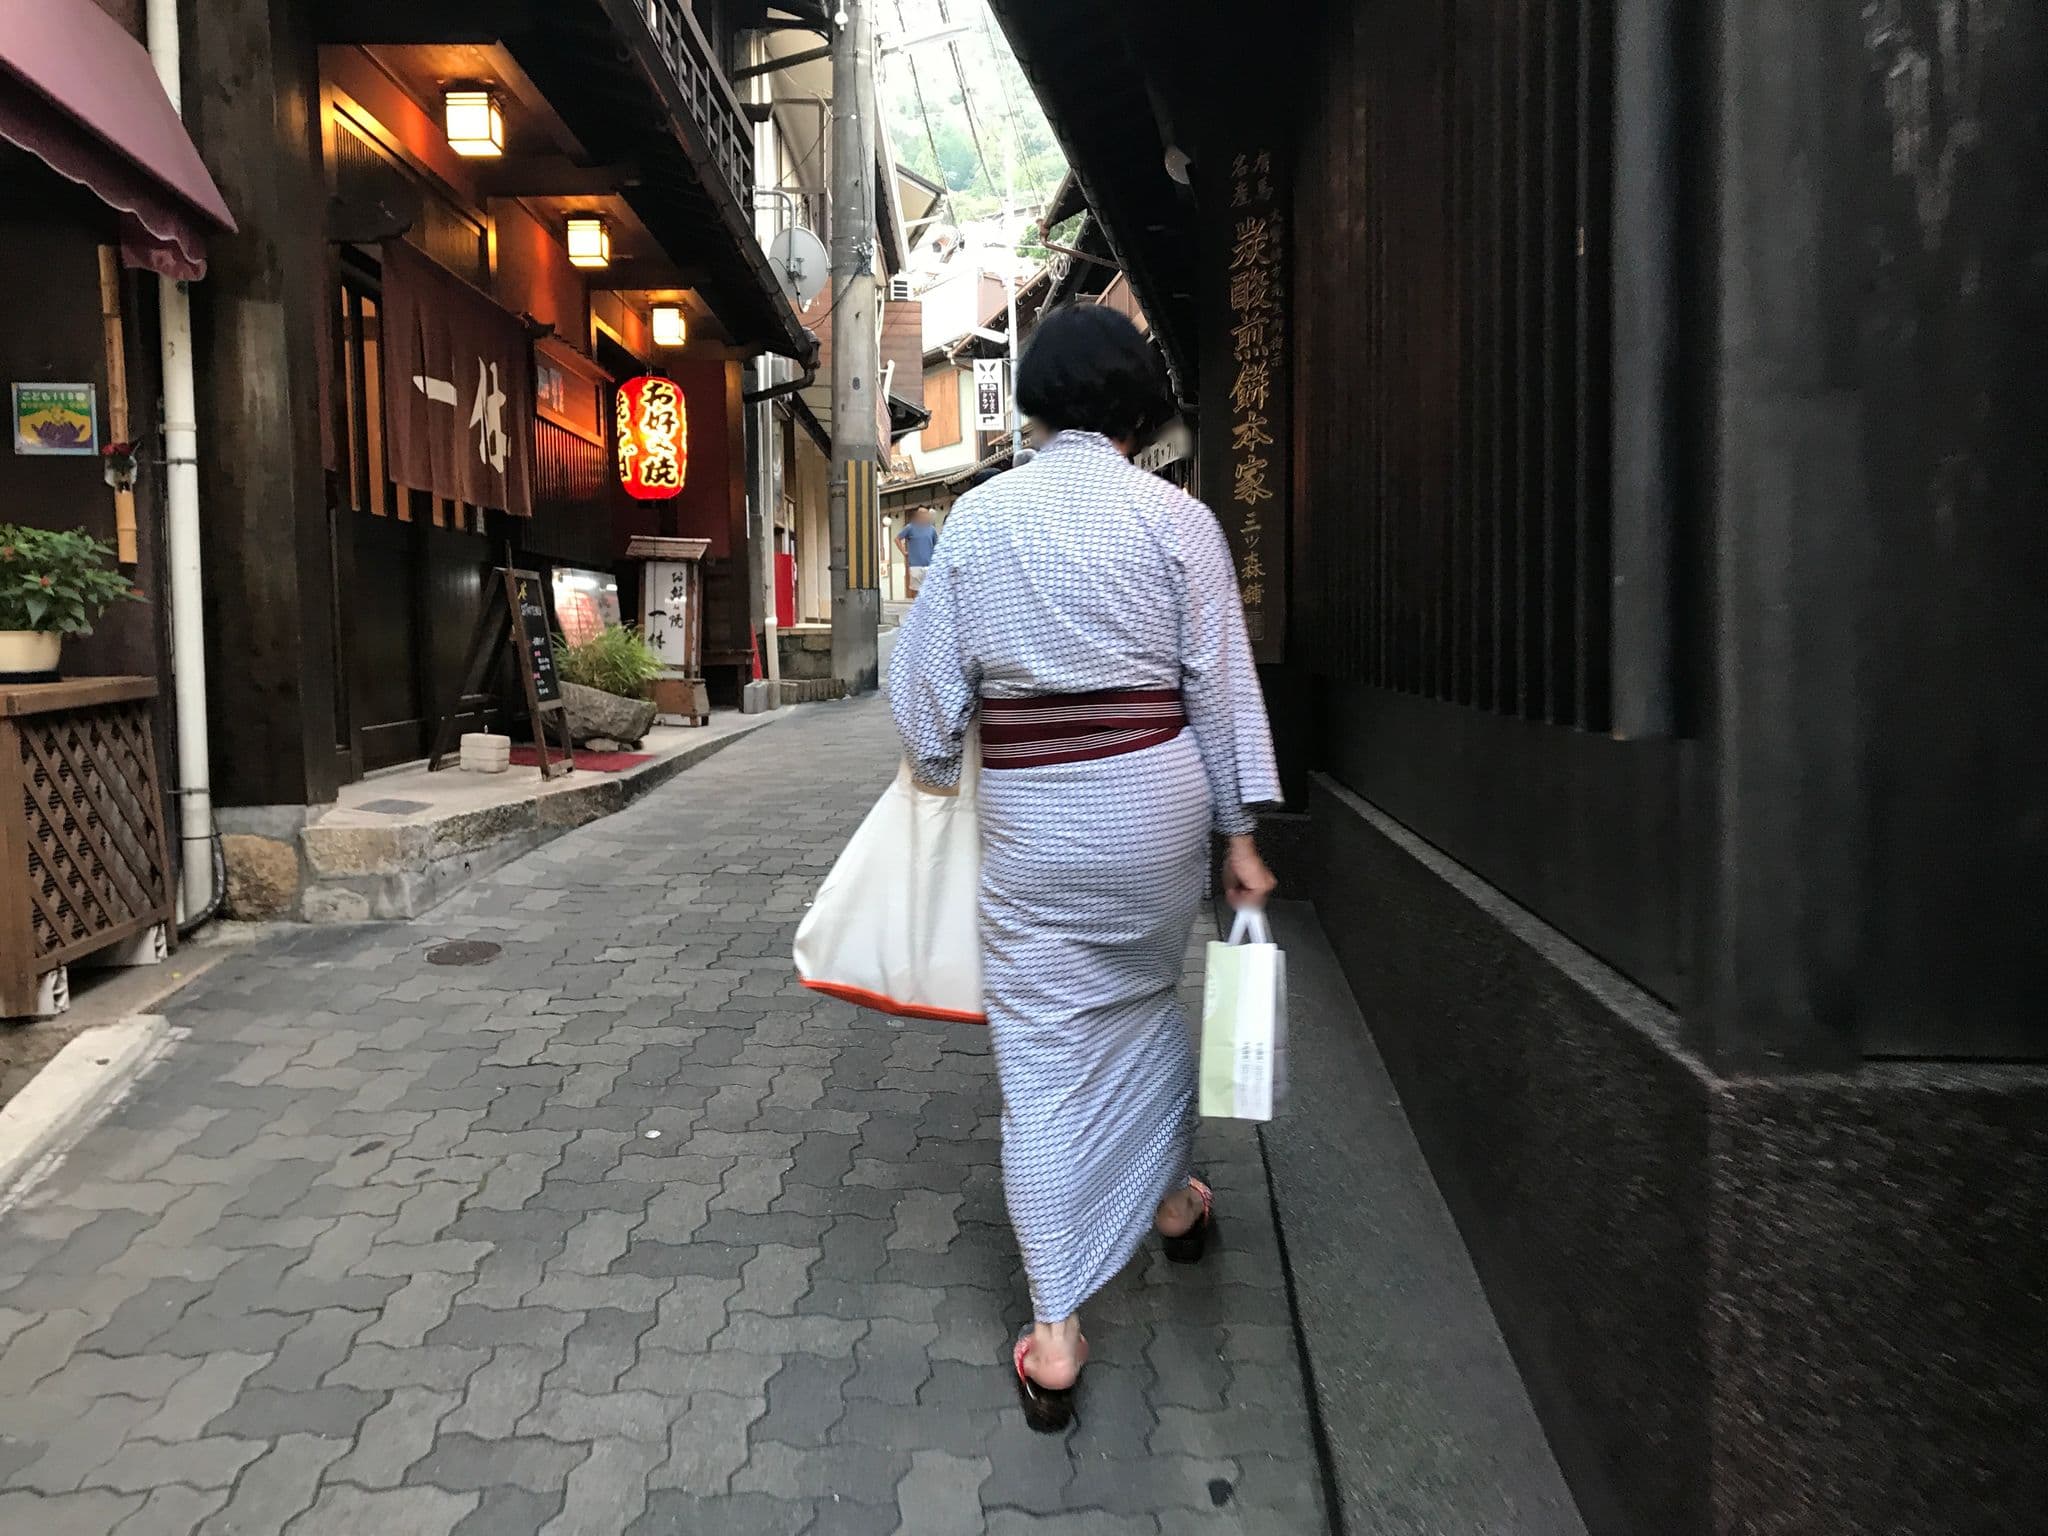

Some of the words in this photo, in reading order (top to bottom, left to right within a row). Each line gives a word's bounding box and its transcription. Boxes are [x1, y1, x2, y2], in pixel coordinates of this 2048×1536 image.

[1229, 216, 1274, 506] 炭酸煎餅本家
[648, 610, 666, 650] 一休
